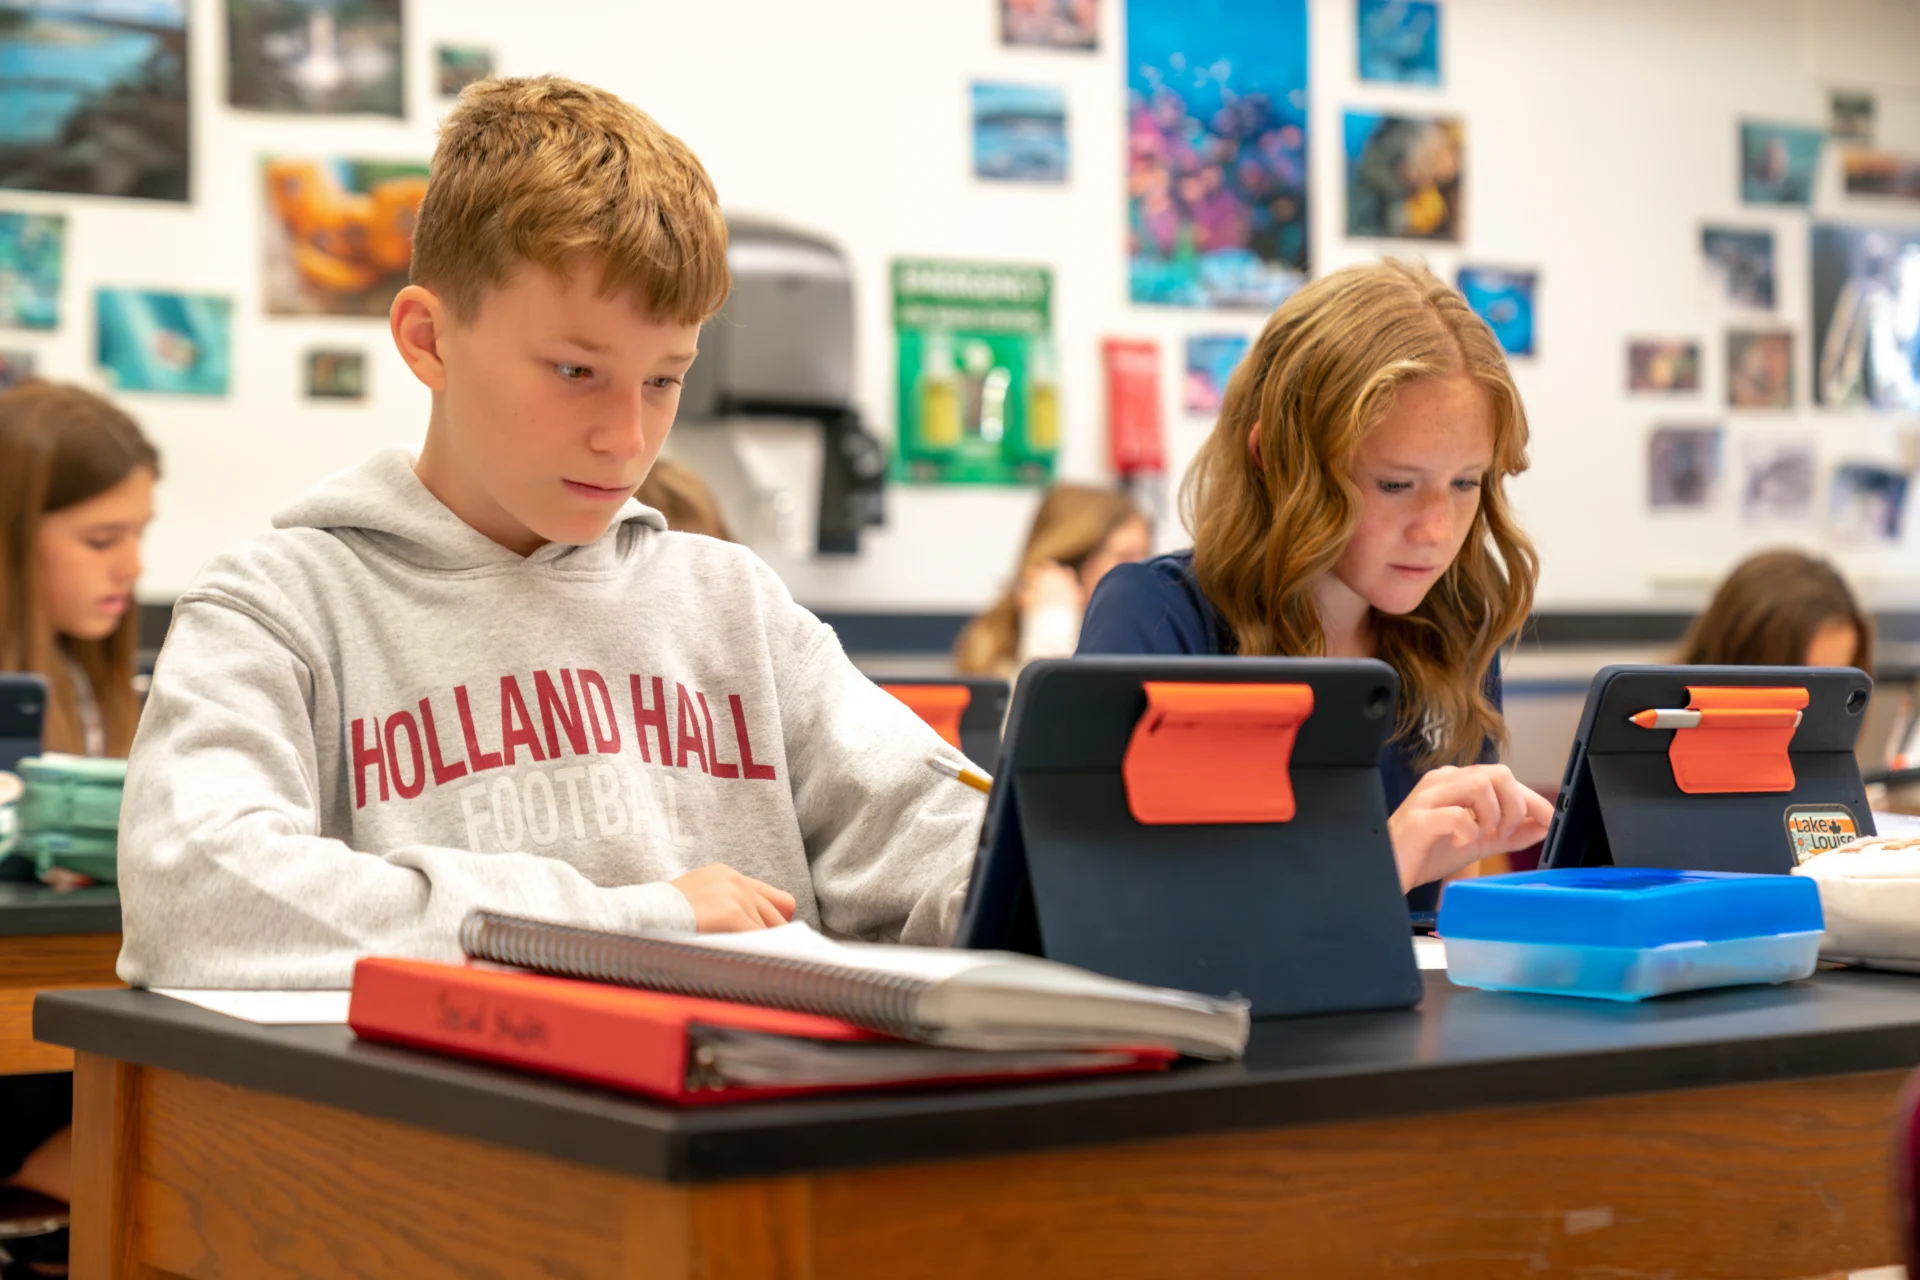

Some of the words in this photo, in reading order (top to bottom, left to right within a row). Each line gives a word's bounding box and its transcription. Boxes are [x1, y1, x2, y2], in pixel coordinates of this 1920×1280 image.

[351, 668, 621, 810] HOLLAND
[629, 673, 776, 781] HALL
[1794, 816, 1829, 833] Lake
